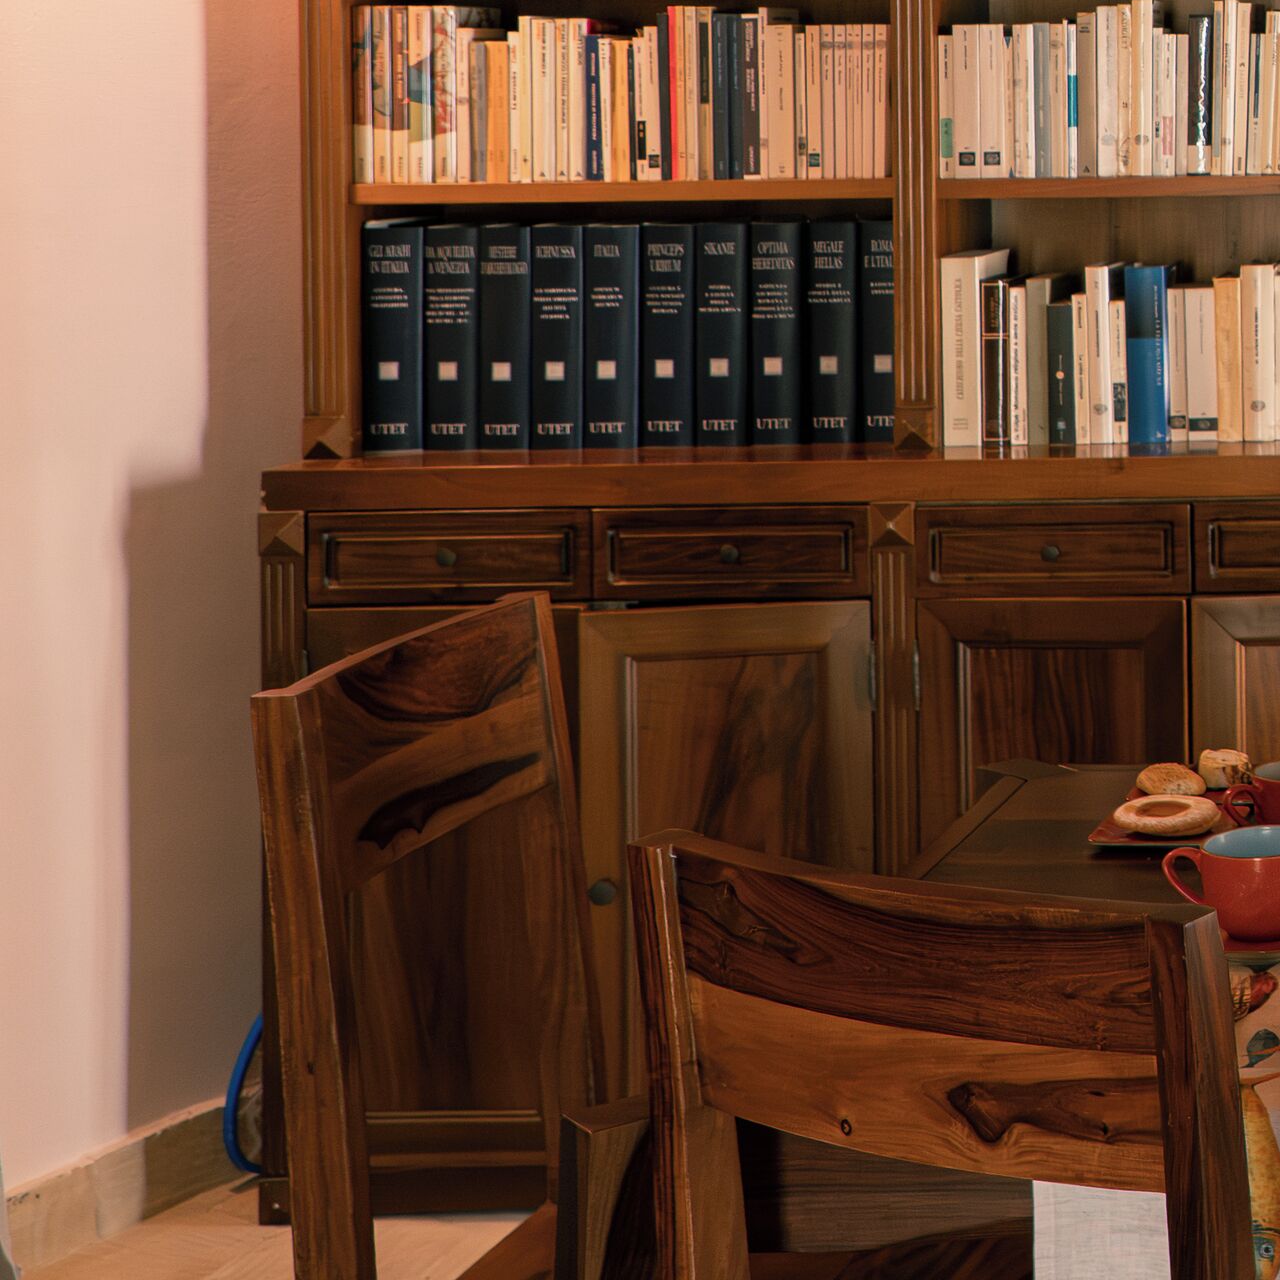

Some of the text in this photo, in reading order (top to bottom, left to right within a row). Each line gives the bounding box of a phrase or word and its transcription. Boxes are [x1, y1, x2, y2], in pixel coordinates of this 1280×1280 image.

[648, 243, 684, 256] PRINCEPS
[758, 242, 789, 254] OPTIMA
[813, 241, 844, 254] MEGALE
[815, 256, 843, 269] HELLAS
[954, 277, 963, 313] CATTOLICA
[954, 314, 964, 338] CHIESA
[954, 338, 964, 358] DELLA
[538, 423, 574, 434] UTET
[589, 422, 626, 433] UTET
[648, 421, 684, 432] UTET
[703, 420, 738, 431] UTET
[756, 418, 792, 430] UTET
[813, 417, 848, 428] UTET
[370, 423, 409, 435] UTET
[431, 423, 467, 435] UTET
[484, 424, 520, 435] UTET
